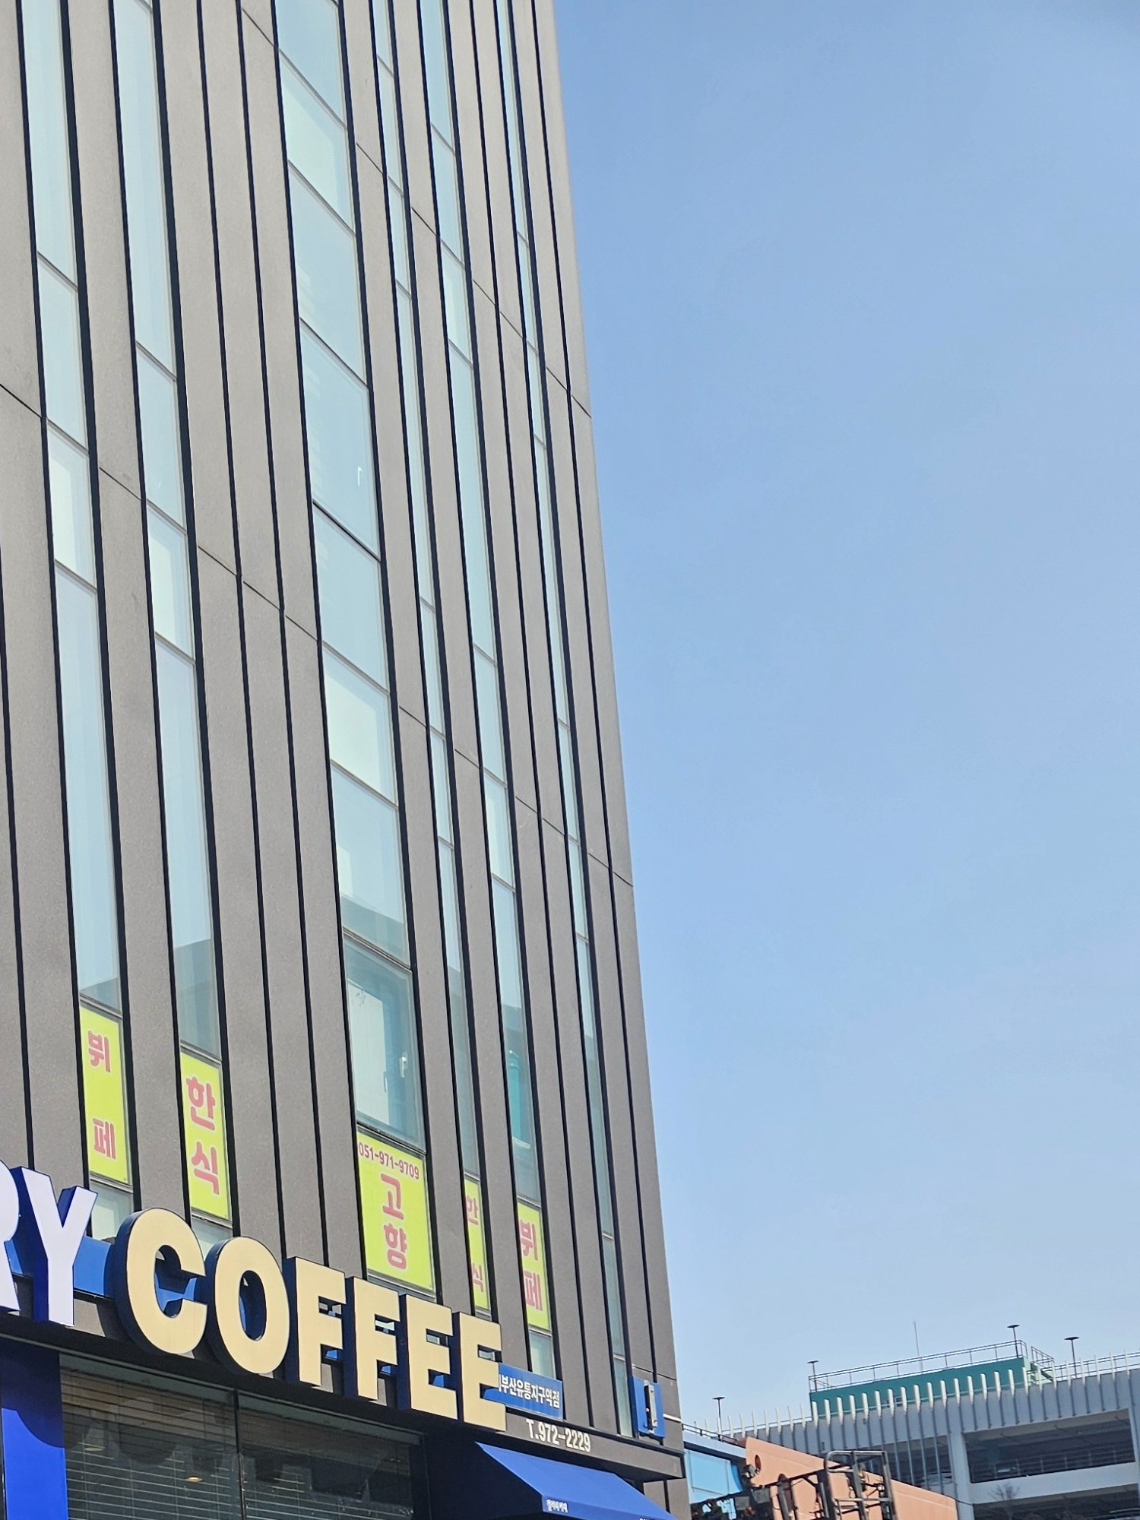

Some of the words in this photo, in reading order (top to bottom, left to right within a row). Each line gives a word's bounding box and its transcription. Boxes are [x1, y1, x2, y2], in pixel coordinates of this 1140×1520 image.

[87, 1030, 117, 1160] 뷔페
[185, 1076, 220, 1195] 한식
[359, 1142, 420, 1181] 051-971-9709
[380, 1173, 408, 1270] 고향
[520, 1219, 543, 1312] 뷔페
[123, 1207, 507, 1432] COFFEE
[525, 1418, 591, 1453] T.972-2229
